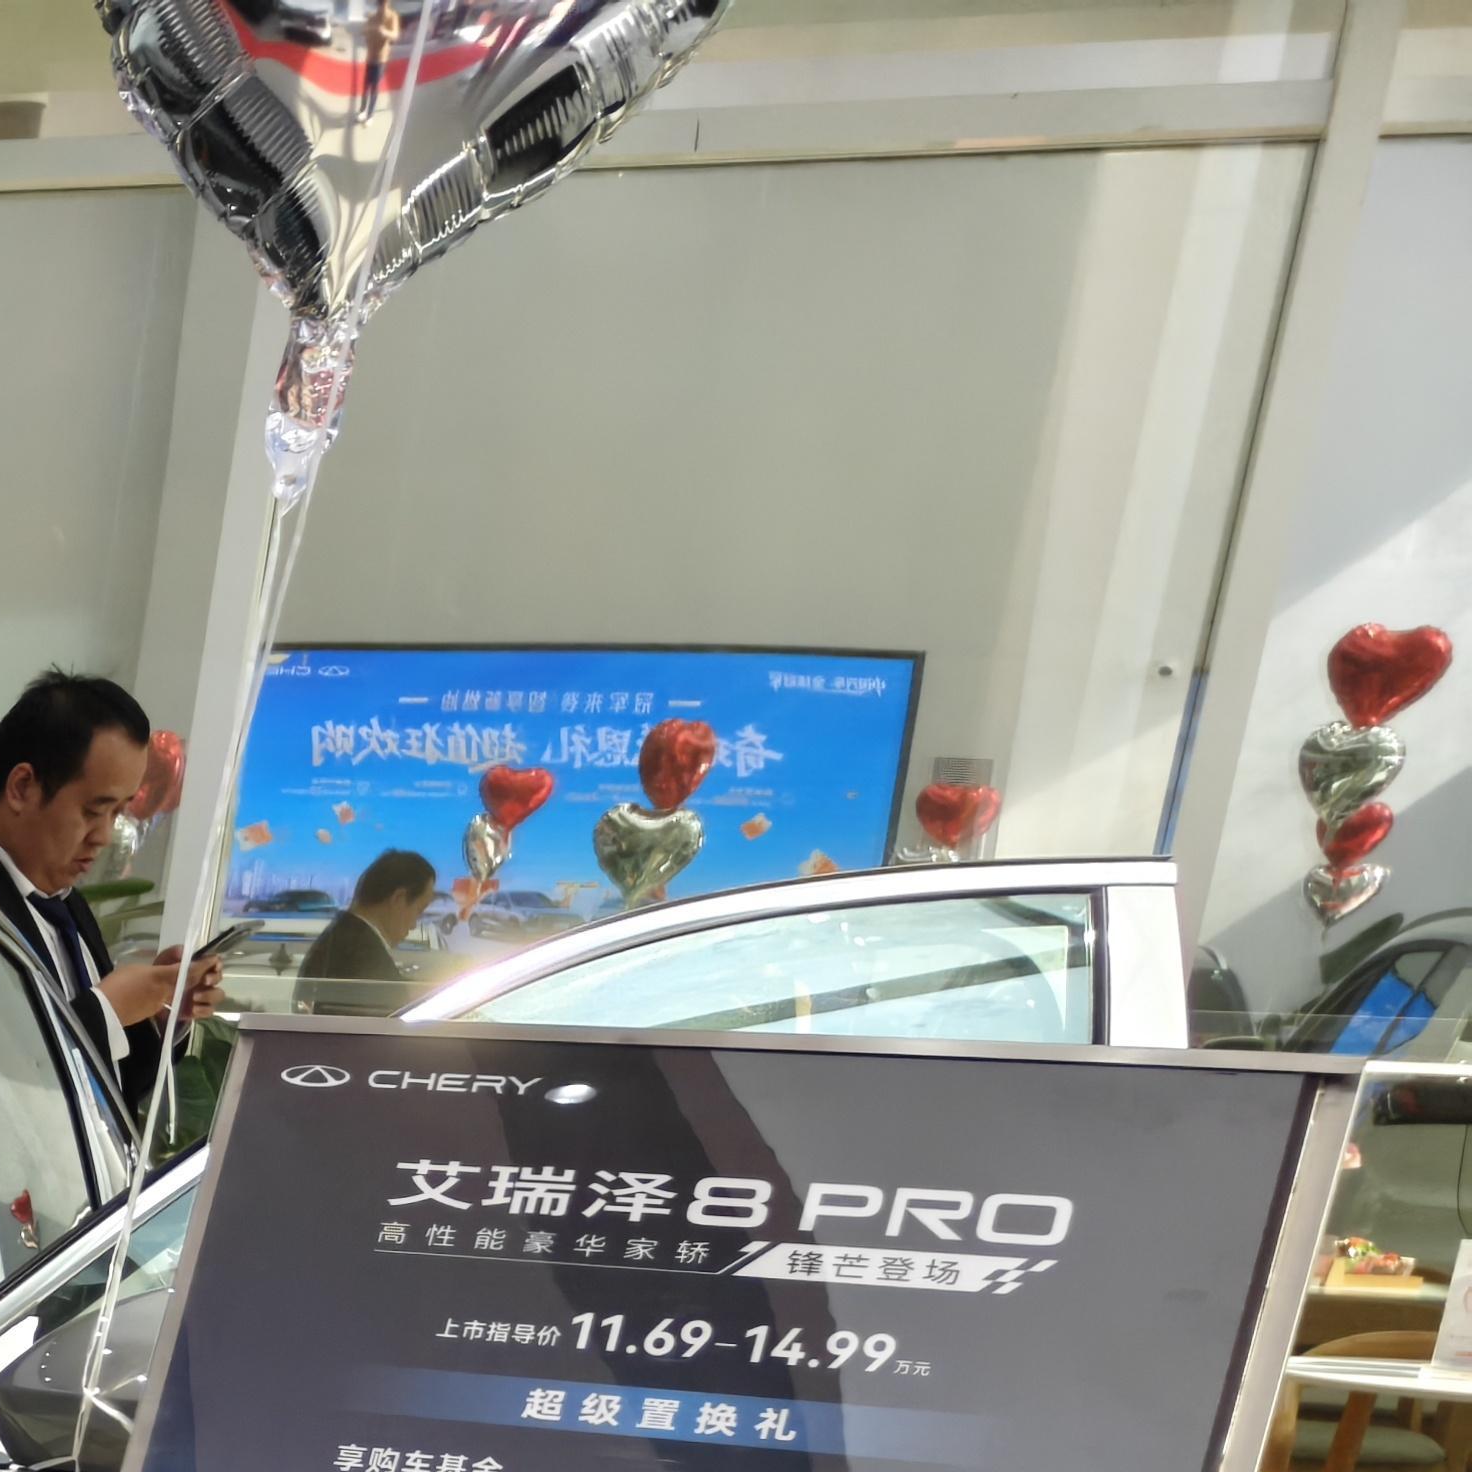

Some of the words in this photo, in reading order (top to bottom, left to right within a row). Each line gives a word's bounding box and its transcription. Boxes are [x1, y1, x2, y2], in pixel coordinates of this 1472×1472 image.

[367, 1069, 543, 1096] CHERY
[387, 1159, 773, 1229] 艾瑞泽8
[797, 1182, 1074, 1246] PRO
[377, 1221, 710, 1265] 高性能豪华家轿
[786, 1248, 961, 1286] 锋芒登场
[520, 1388, 798, 1442] 超级置换礼
